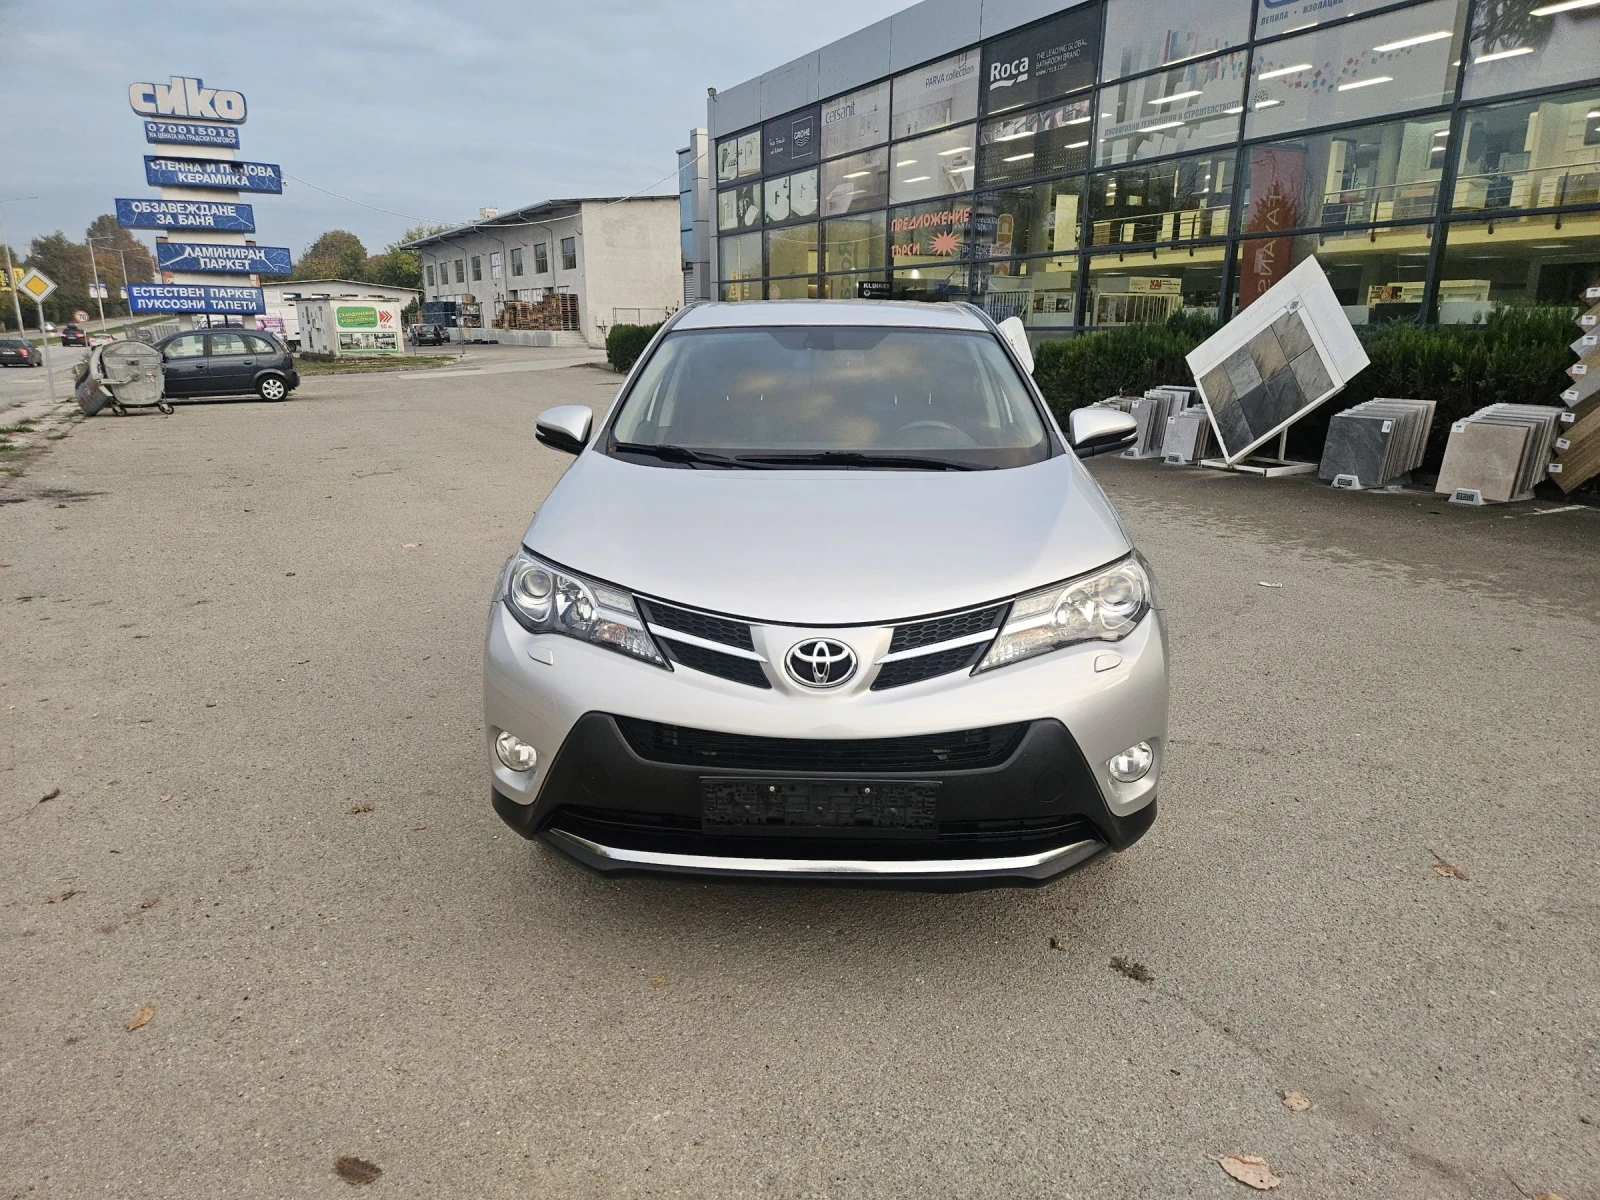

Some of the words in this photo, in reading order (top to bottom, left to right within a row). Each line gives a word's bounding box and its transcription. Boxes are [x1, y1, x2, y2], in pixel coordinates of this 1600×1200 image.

[1036, 52, 1046, 60] THE
[1046, 44, 1068, 58] LEADING
[1068, 37, 1088, 52] GLOBAL
[1035, 55, 1063, 70] BATHROOM
[1063, 48, 1081, 61] BRAND
[925, 74, 946, 88] PARVA
[945, 64, 975, 82] collection
[990, 57, 1029, 82] Roca
[825, 100, 856, 124] cersanit
[158, 132, 178, 140] ЦЕНАТА
[186, 134, 210, 143] ГРАДСКИ
[210, 136, 237, 145] РАЗГОВОР
[793, 127, 811, 140] GROHE
[150, 160, 203, 173] СТЕННА
[206, 163, 216, 173] И
[178, 172, 250, 187] КЕРАМИКА
[132, 201, 237, 217] ОБЗАВЕЖДАНЕ
[156, 213, 175, 225] ЗА
[179, 215, 214, 227] БАНЯ
[891, 207, 973, 232] ПРЕДЛОЖЕНИЕ
[184, 246, 265, 260] ЛАМИНИРАН
[200, 258, 251, 270] ПАРКЕТ
[133, 286, 205, 298] ЕСТЕСТВЕН
[210, 288, 258, 299] ПАРКЕТ
[137, 299, 206, 309] ЛУКСОЗНИ
[212, 300, 257, 311] ТАПЕТИ
[78, 313, 87, 321] 70
